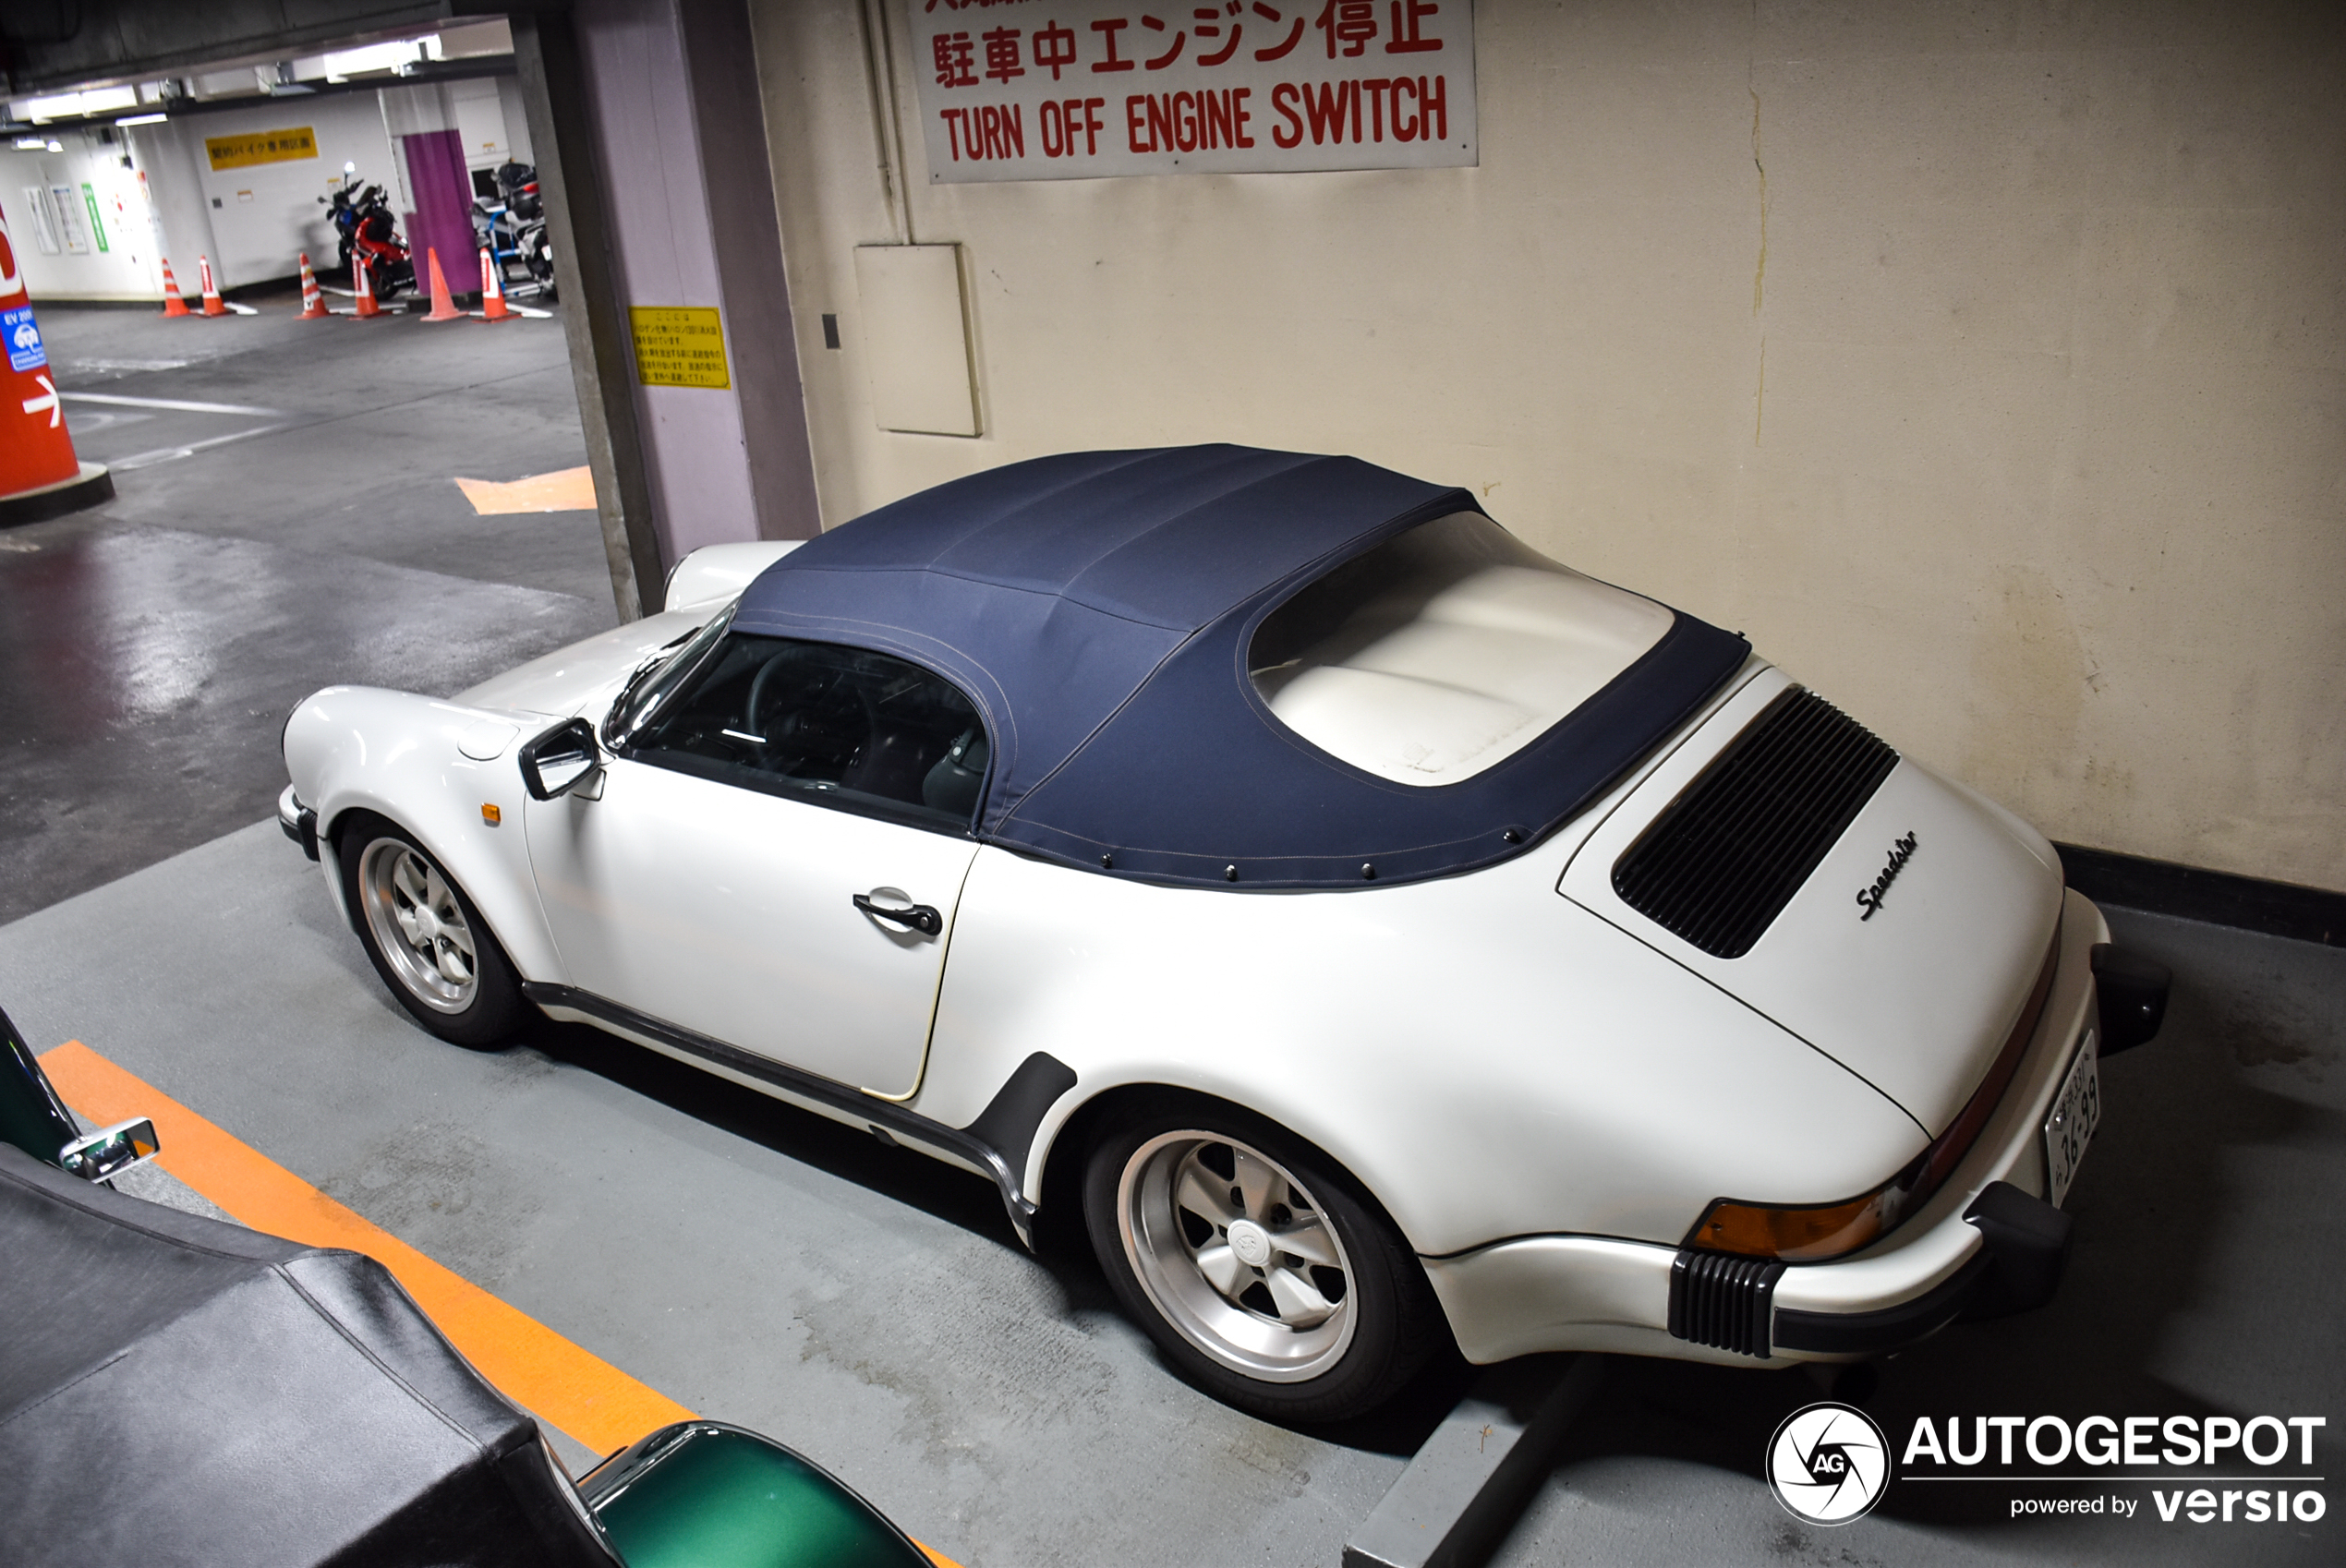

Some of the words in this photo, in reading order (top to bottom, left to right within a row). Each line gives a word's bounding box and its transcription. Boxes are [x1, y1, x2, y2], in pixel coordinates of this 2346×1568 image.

[932, 0, 1444, 89] 駐車中エンジン停止
[940, 103, 1024, 162] TURN
[1039, 98, 1105, 158] OFF
[1126, 87, 1254, 153] ENGINE
[1272, 75, 1447, 149] SWITCH
[1856, 830, 1918, 922] Speedster
